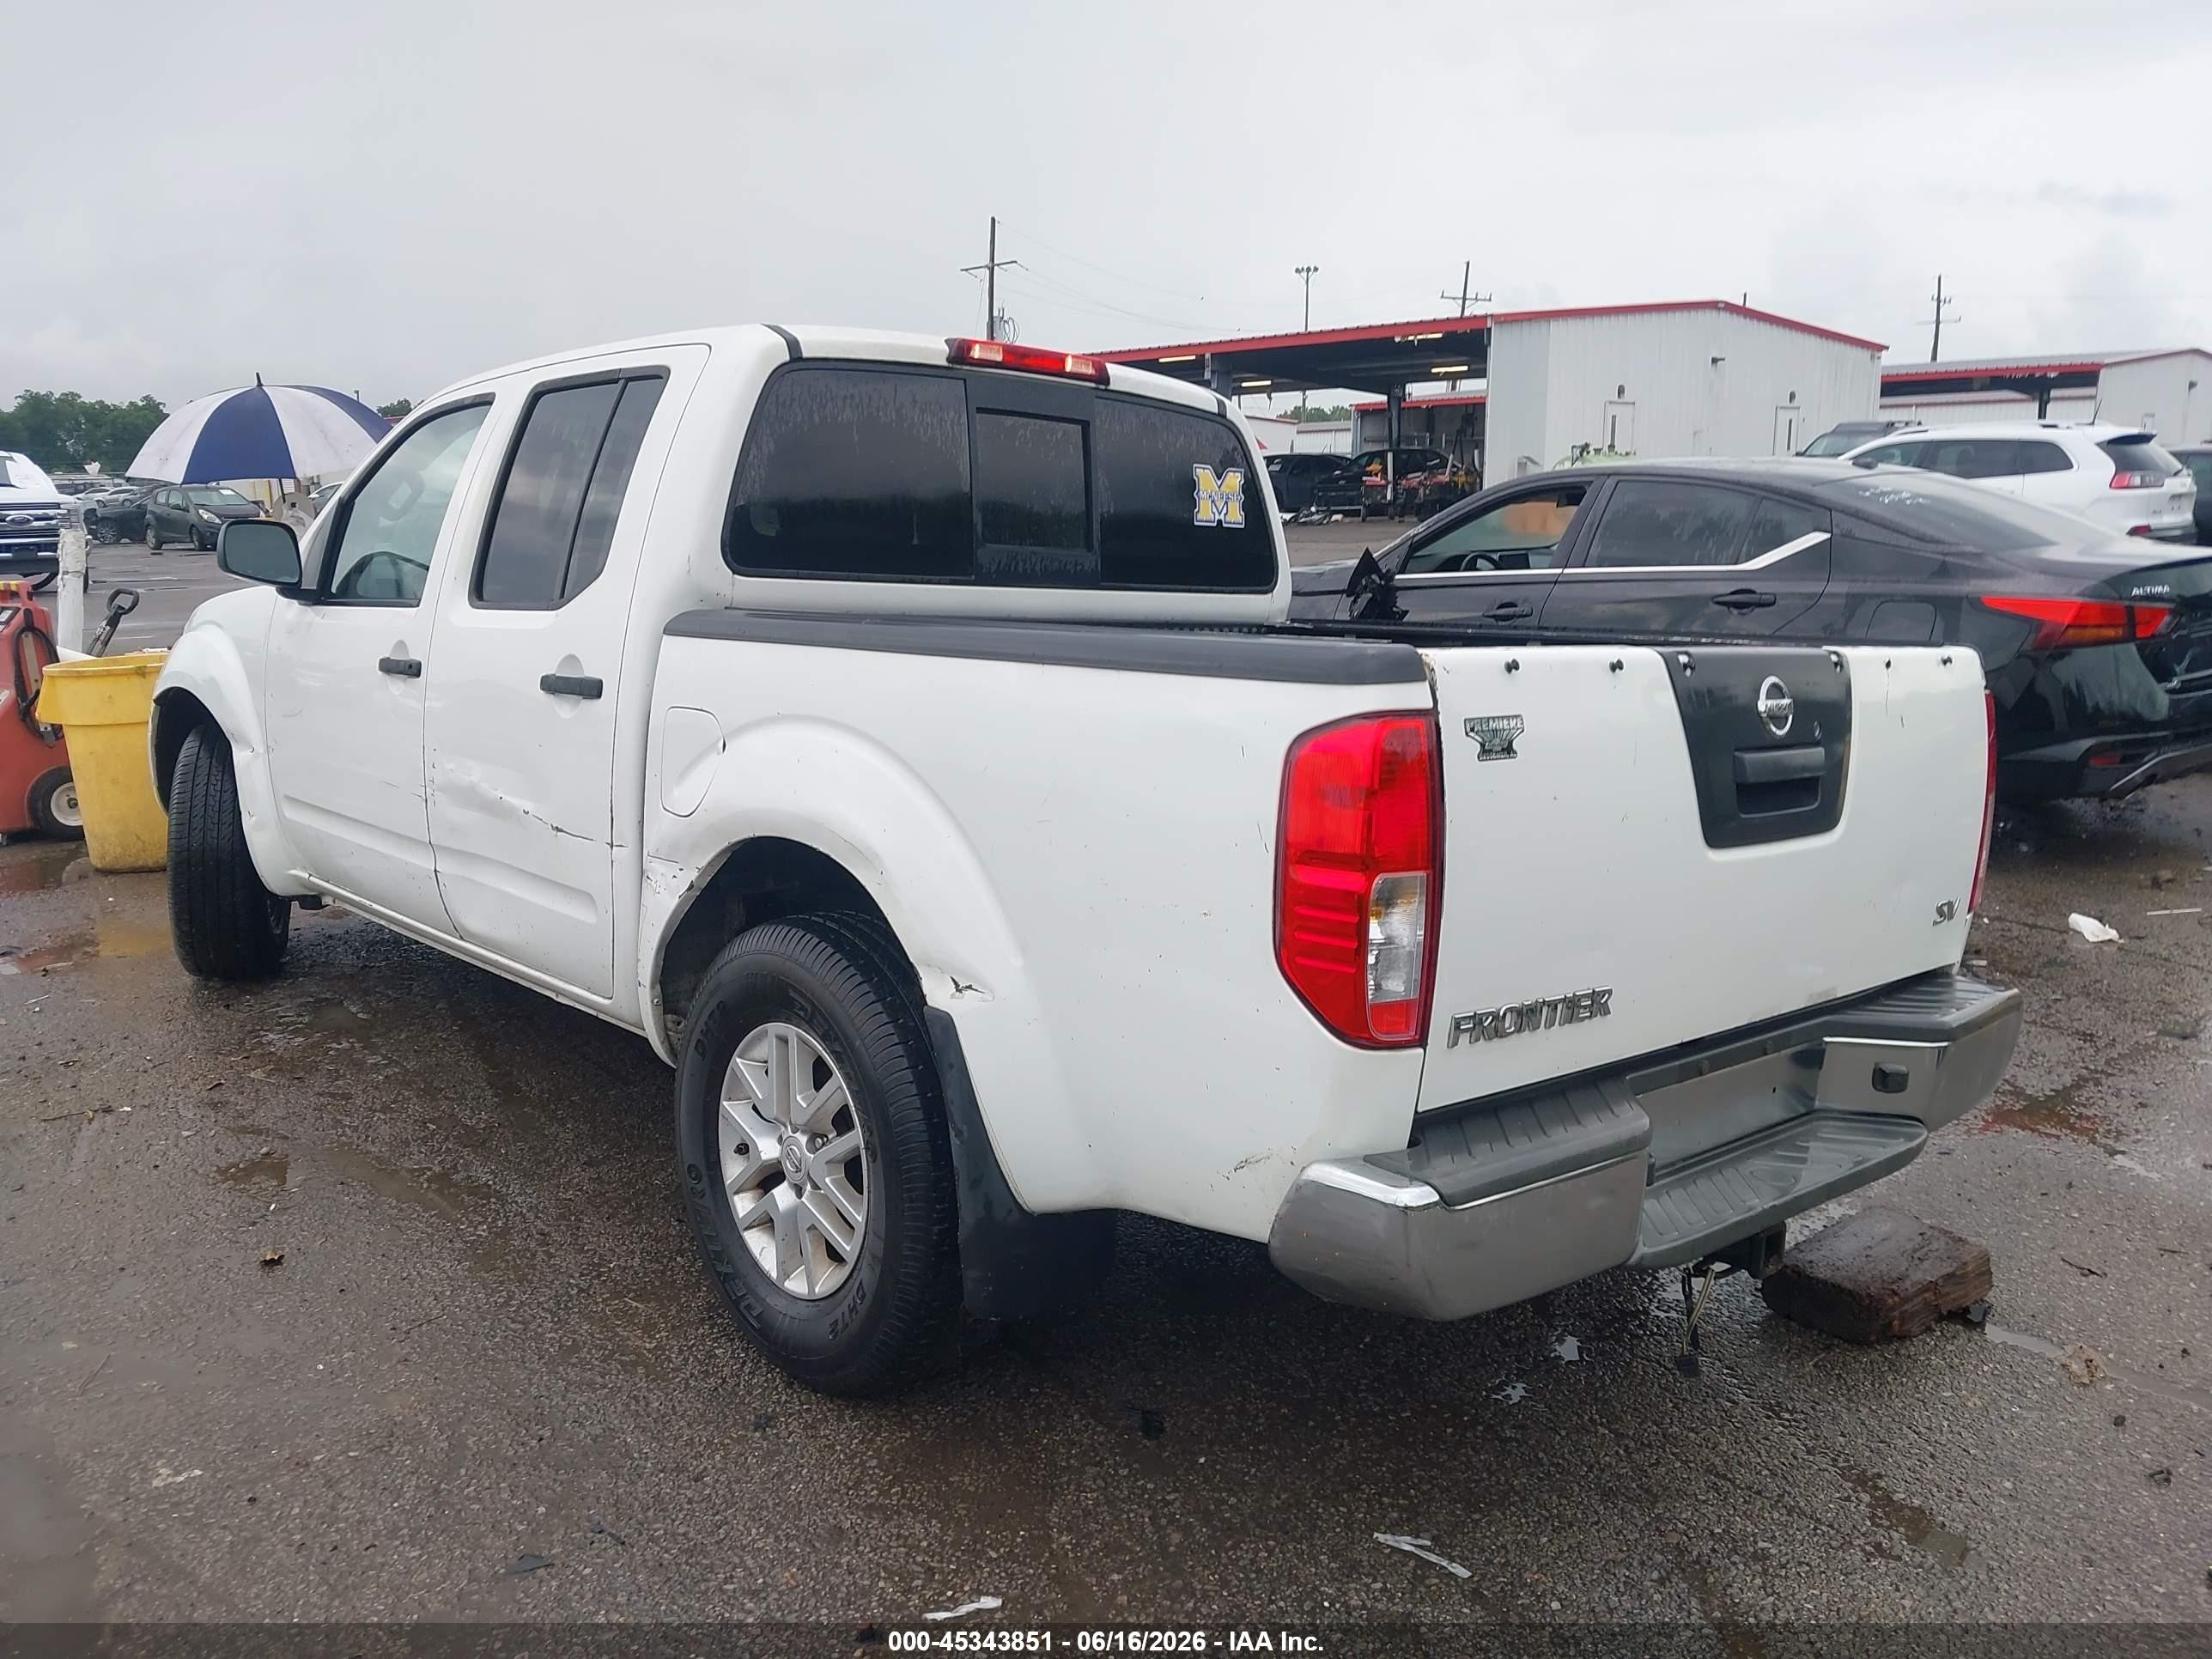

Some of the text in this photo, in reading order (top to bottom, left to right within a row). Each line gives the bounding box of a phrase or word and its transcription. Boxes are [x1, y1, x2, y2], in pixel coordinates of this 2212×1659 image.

[1194, 465, 1244, 528] M
[2131, 585, 2170, 596] ALTIMA
[1932, 896, 1960, 926] SV
[1447, 986, 1613, 1048] FRONTIER
